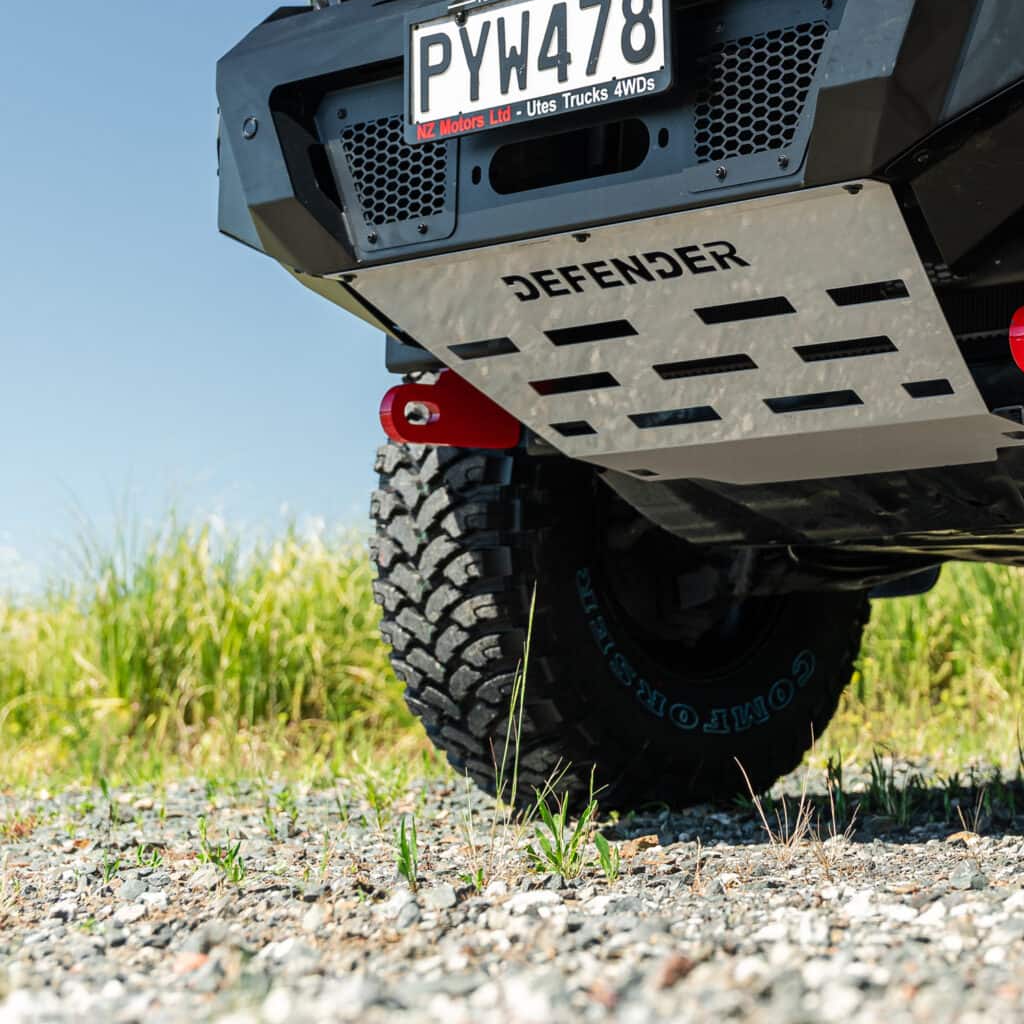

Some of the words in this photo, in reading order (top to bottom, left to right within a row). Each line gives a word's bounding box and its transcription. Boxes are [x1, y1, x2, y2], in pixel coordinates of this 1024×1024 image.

[417, 122, 436, 140] NZ
[440, 115, 485, 136] Motors
[489, 106, 512, 125] Ltd
[527, 99, 557, 117] Utes
[562, 87, 609, 109] Trucks
[614, 76, 655, 97] 4WDs
[501, 240, 751, 302] DEFENDER
